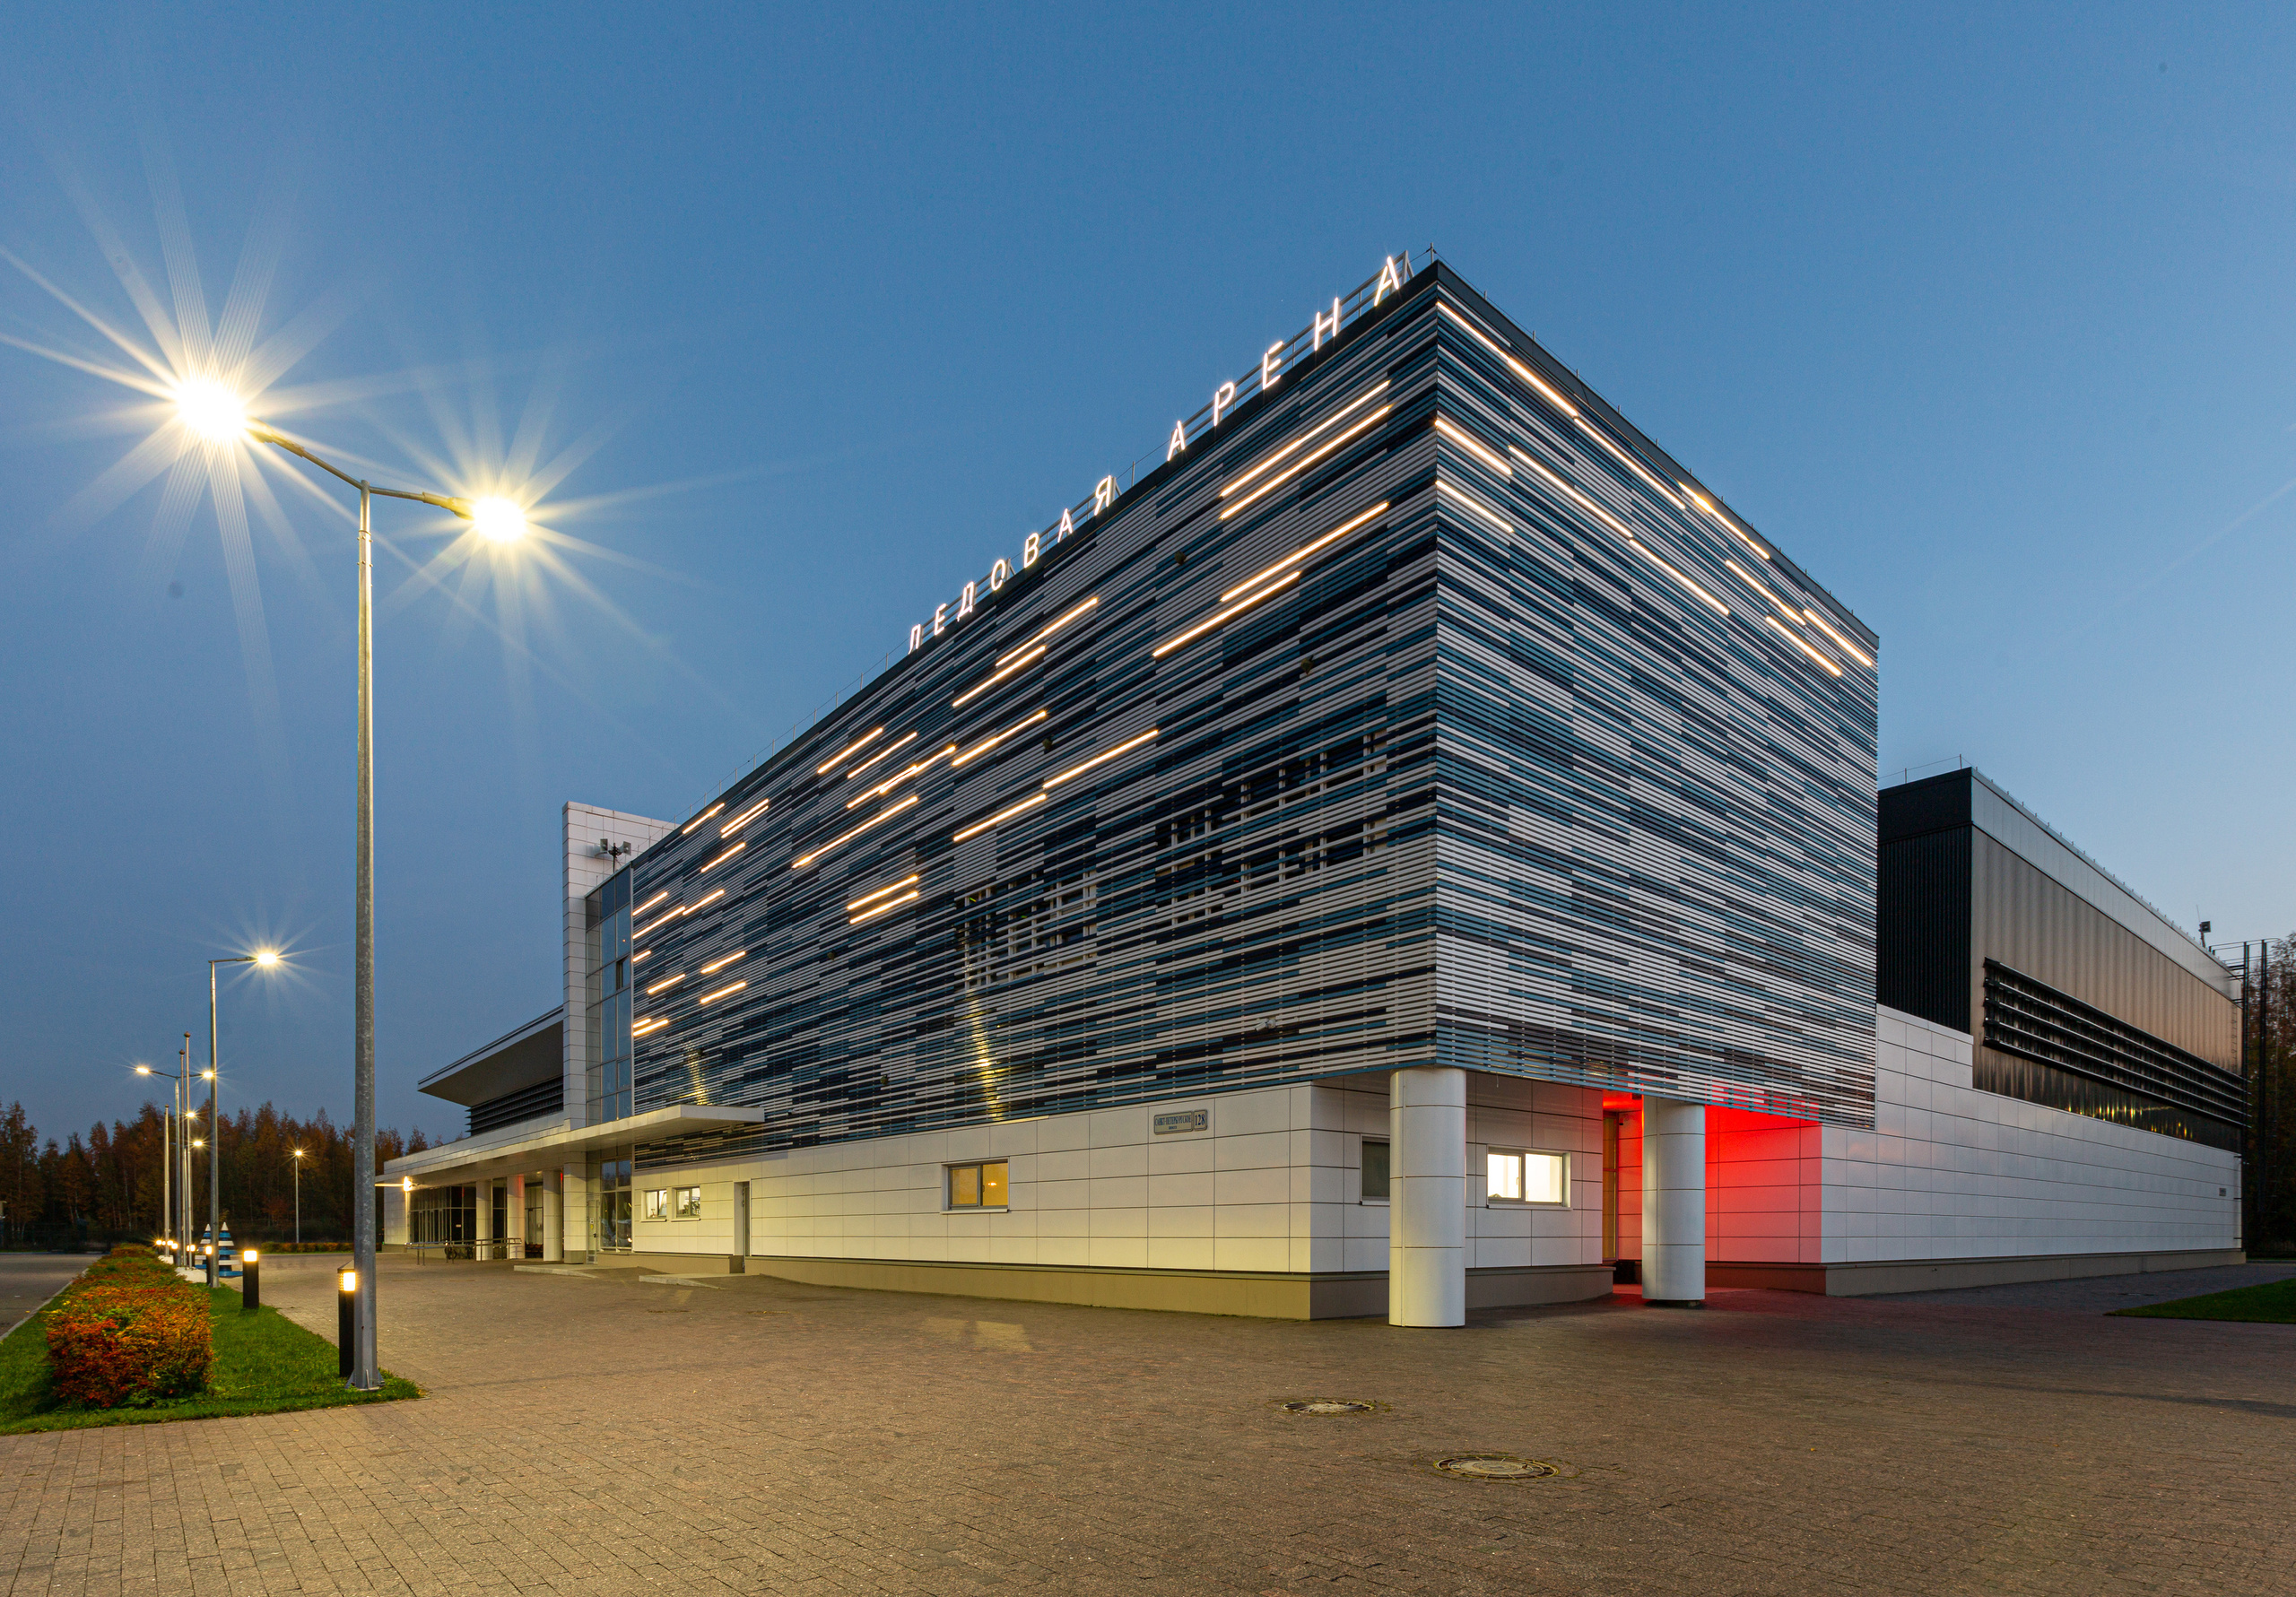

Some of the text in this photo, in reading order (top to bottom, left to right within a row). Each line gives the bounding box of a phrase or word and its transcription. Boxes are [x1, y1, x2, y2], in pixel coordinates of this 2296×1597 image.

[908, 256, 1399, 655] ЛЕДОВАЯ АРЕНА
[1195, 1114, 1205, 1126] 128
